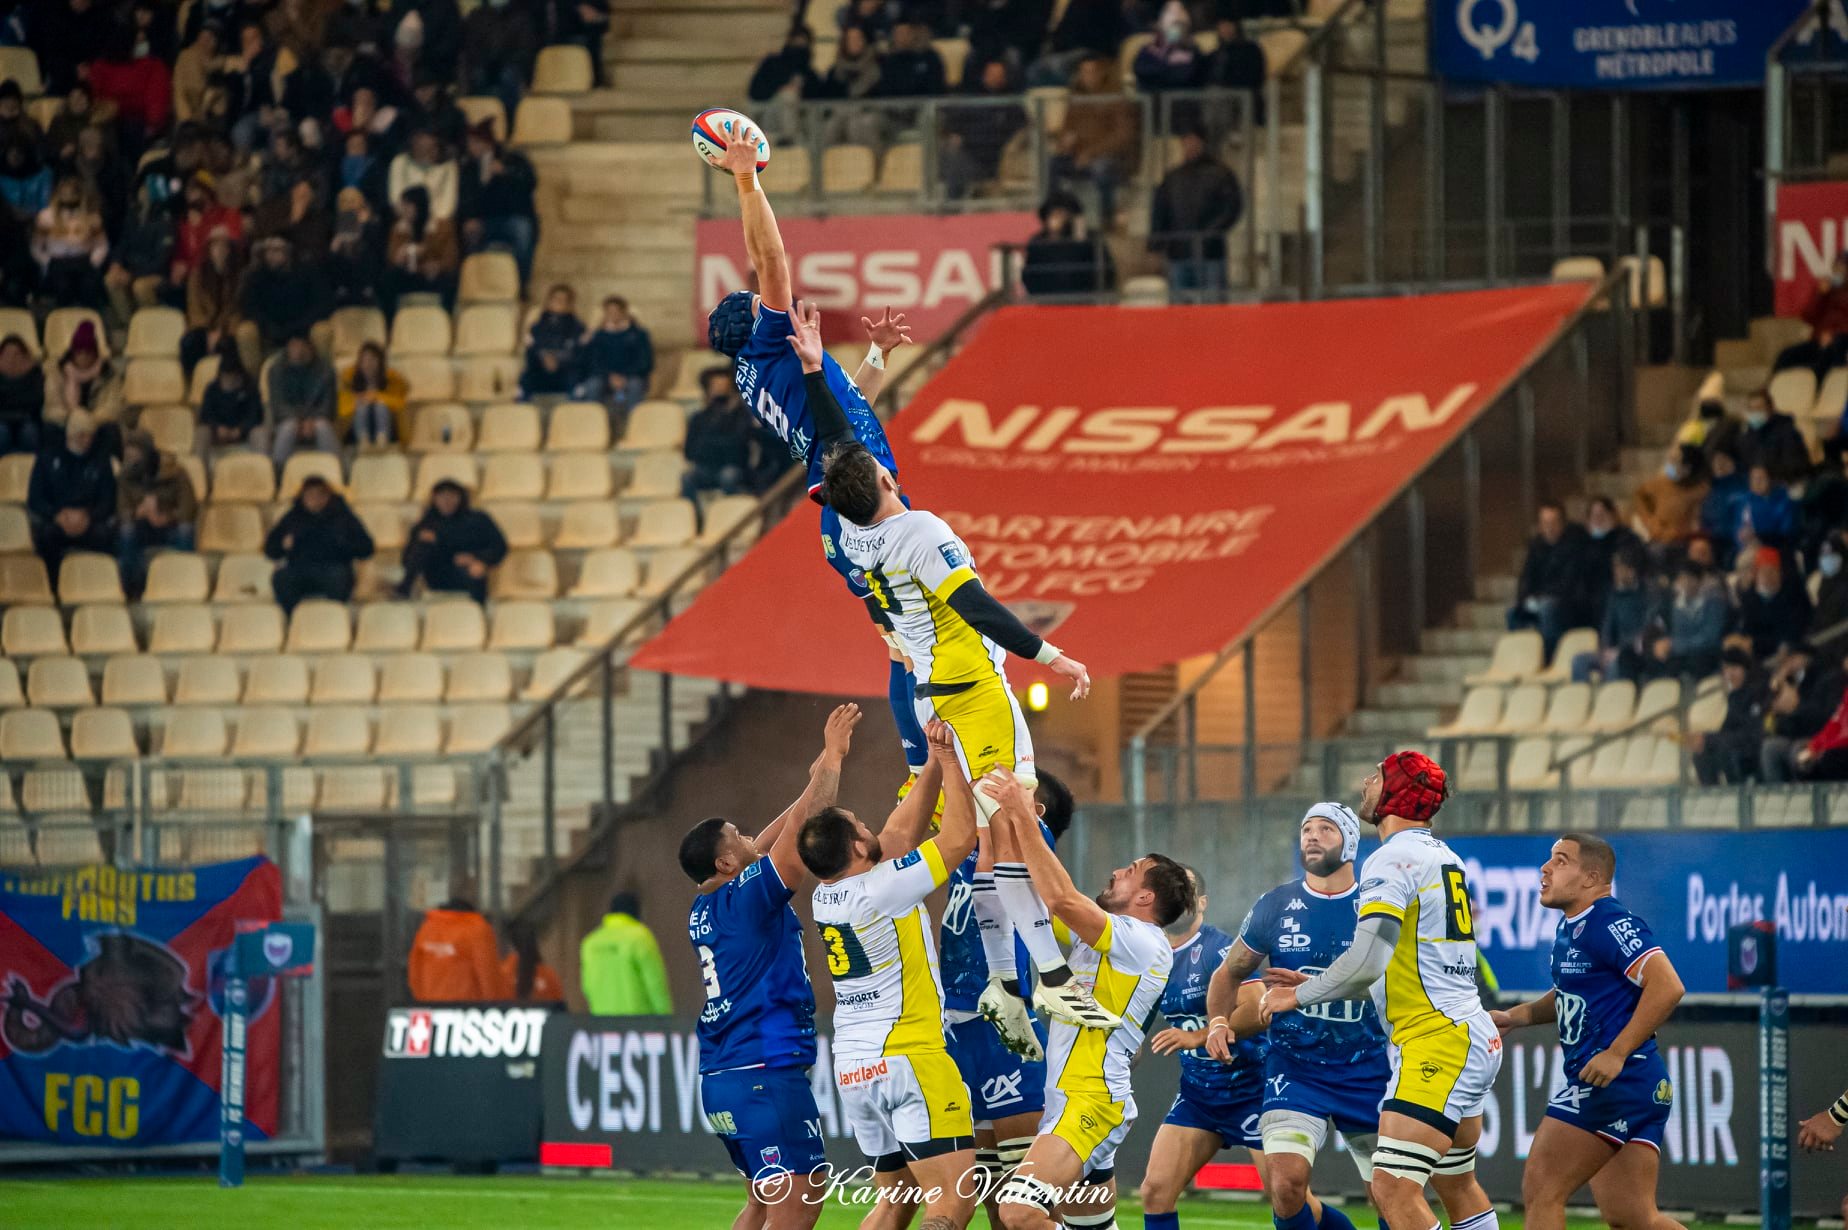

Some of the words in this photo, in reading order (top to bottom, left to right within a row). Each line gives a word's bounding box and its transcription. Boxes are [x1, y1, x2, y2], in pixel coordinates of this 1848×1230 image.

[911, 382, 1478, 453] NISSAN
[968, 534, 1260, 570] TOMOBILE
[1449, 871, 1473, 935] 5
[1687, 873, 1765, 943] Portes
[824, 926, 850, 976] 3
[1278, 934, 1312, 948] SD
[432, 1008, 548, 1057] TISSOT
[567, 1030, 666, 1132] C'EST
